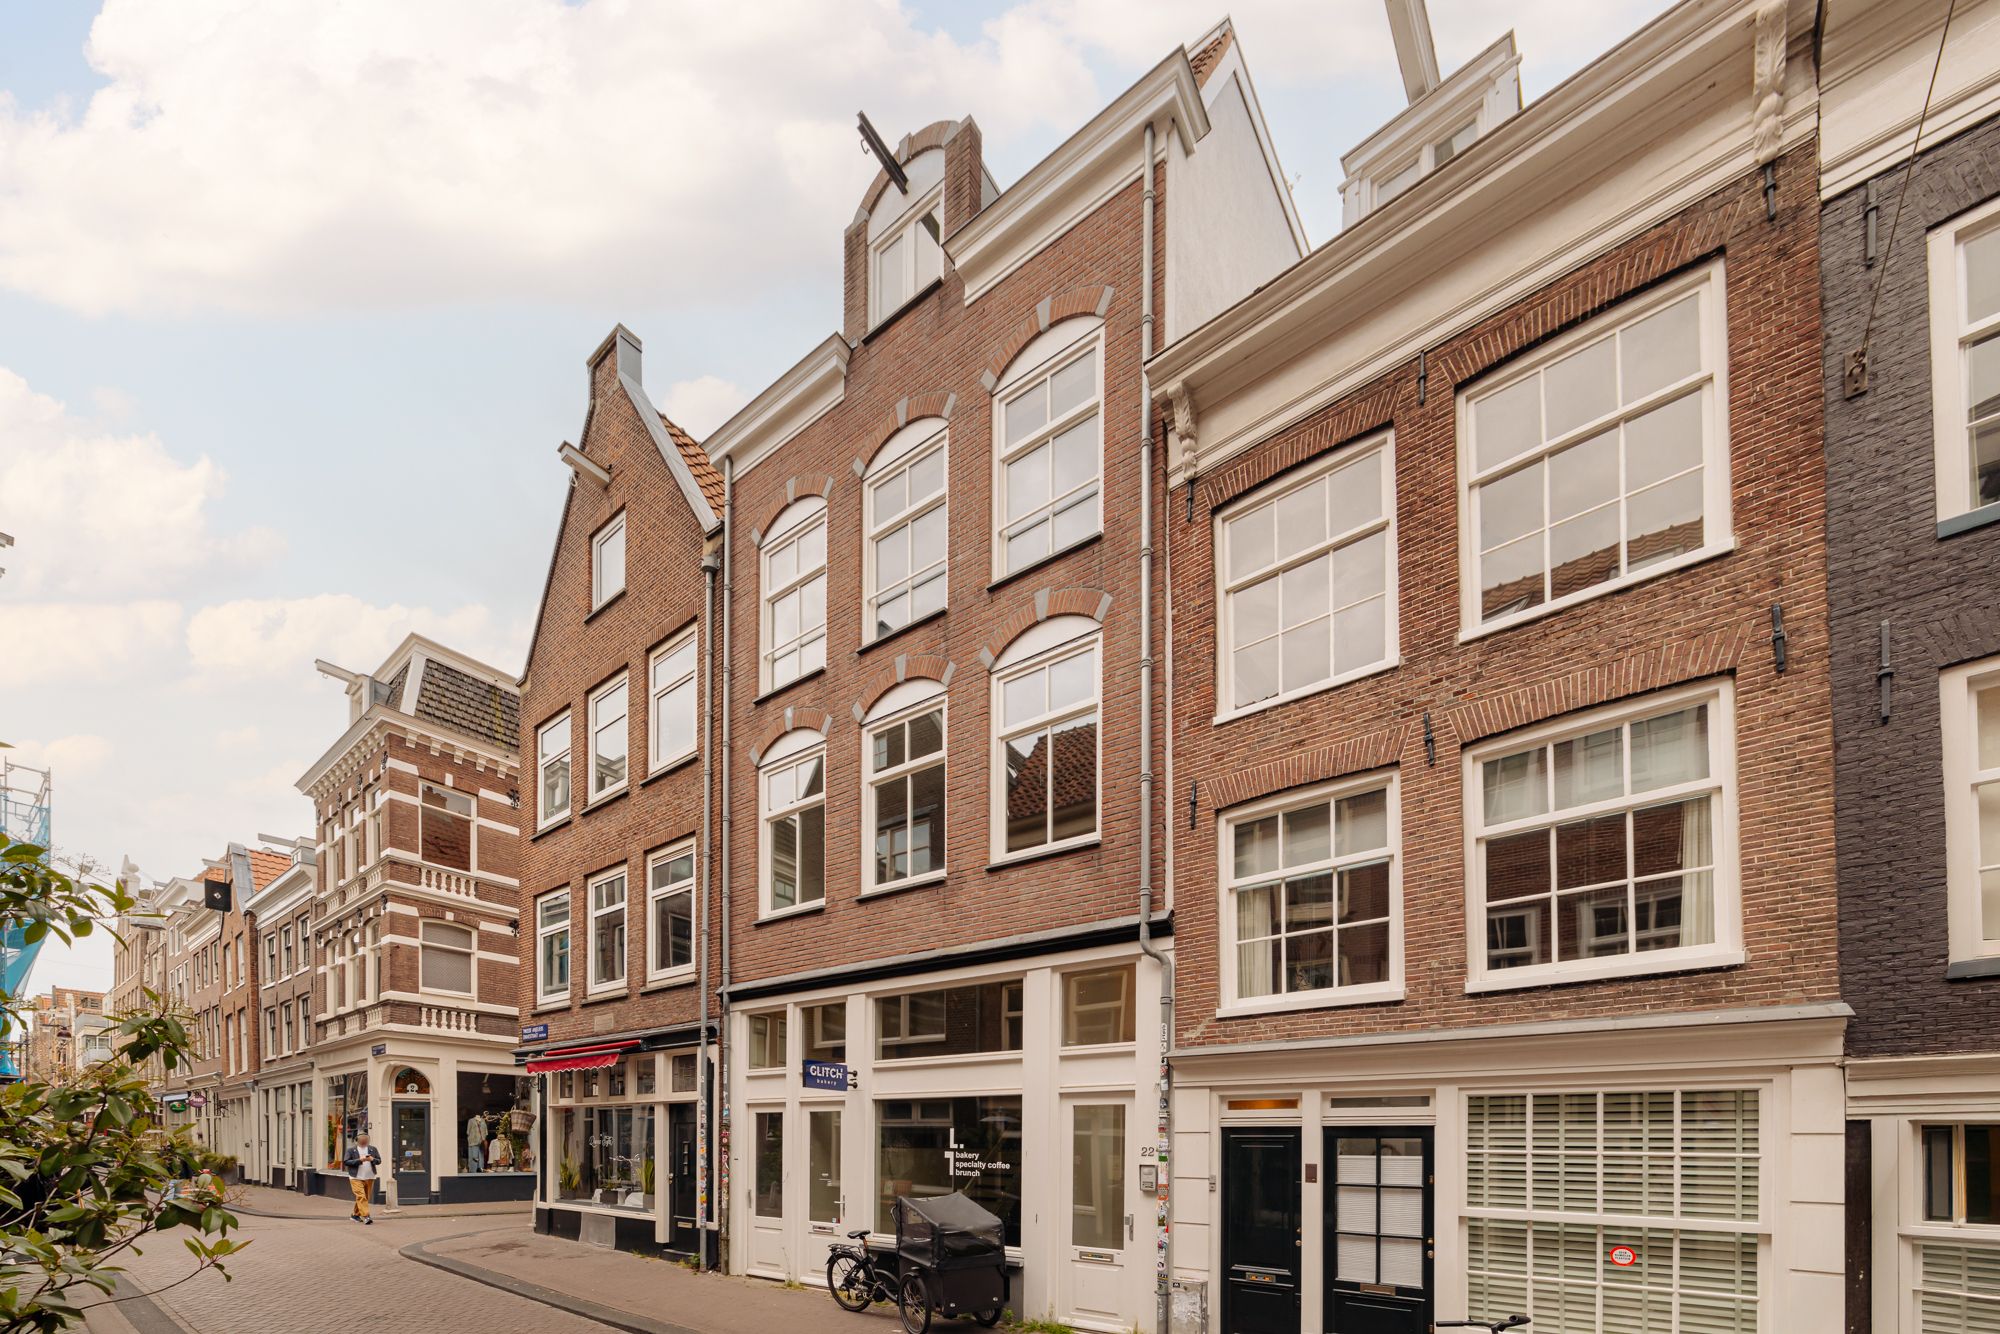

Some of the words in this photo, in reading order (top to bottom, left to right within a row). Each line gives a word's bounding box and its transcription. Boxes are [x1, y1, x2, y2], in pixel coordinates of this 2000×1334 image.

[810, 1065, 843, 1079] GLITCH
[955, 1151, 980, 1160] bakery
[1141, 1147, 1155, 1157] 22
[955, 1161, 986, 1169] specialty
[987, 1161, 1011, 1169] coffee
[955, 1169, 980, 1177] brunch
